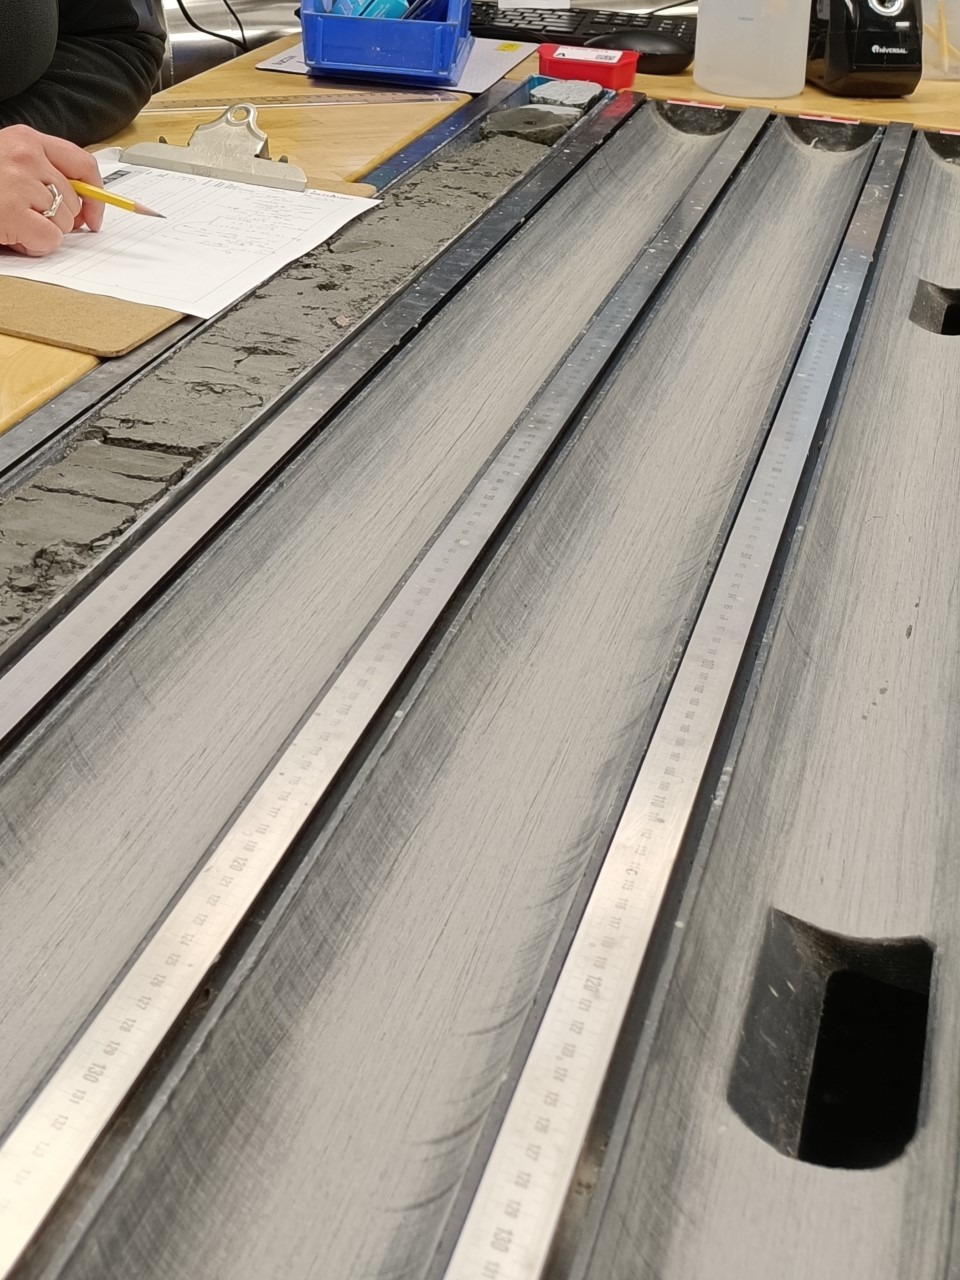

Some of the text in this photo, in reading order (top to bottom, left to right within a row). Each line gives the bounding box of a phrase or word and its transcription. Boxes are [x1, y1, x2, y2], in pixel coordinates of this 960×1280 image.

[228, 856, 248, 872] 120
[206, 894, 222, 907] 122
[178, 932, 196, 946] 124
[164, 952, 182, 967] 125
[150, 974, 168, 988] 126
[583, 974, 603, 994] 120
[136, 995, 152, 1010] 127
[578, 997, 592, 1012] 121
[118, 1018, 136, 1033] 128
[569, 1019, 584, 1036] 122
[102, 1040, 121, 1056] 129
[82, 1062, 108, 1084] 130
[68, 1088, 87, 1105] 131
[50, 1114, 69, 1132] 132
[525, 1142, 542, 1162] 127
[504, 1198, 522, 1220] 129
[490, 1226, 514, 1254] 130
